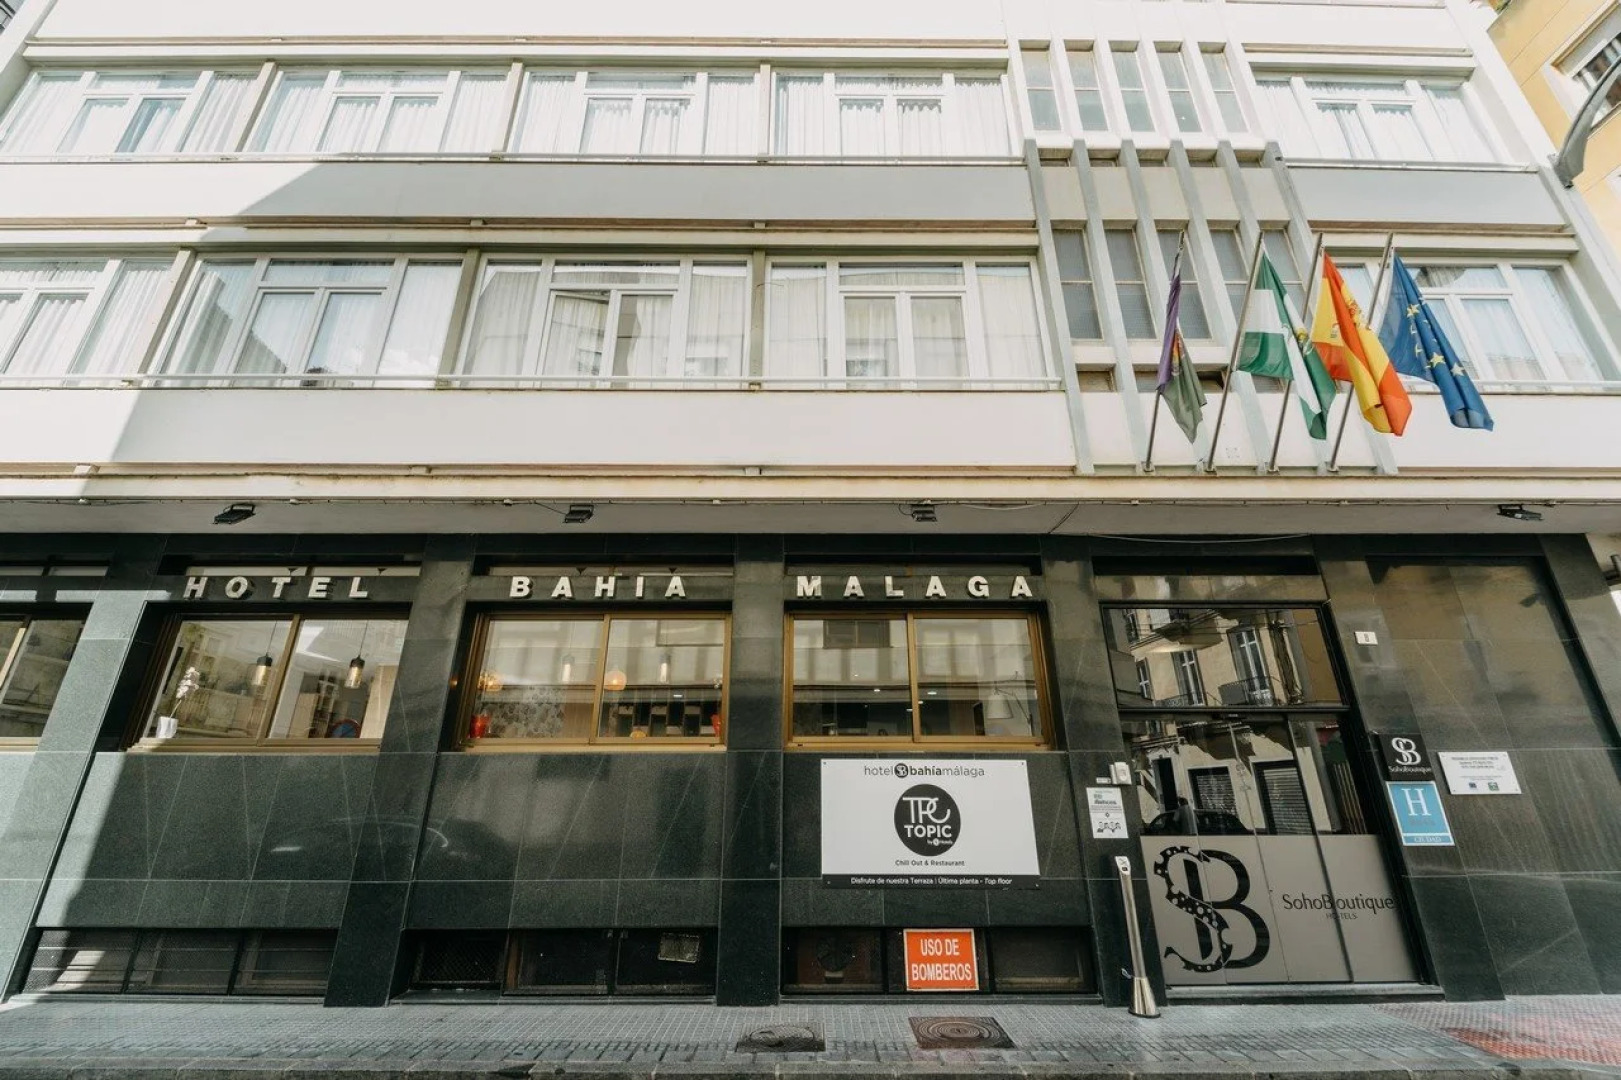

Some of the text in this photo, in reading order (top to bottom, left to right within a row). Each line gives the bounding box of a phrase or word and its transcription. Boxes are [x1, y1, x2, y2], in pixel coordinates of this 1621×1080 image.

[183, 575, 1033, 599] HOTEL BAHIA MALAGA
[1401, 788, 1432, 817] H
[903, 825, 953, 838] TOPIC
[895, 859, 910, 867] Chill
[911, 859, 923, 867] Out
[930, 859, 965, 867] Restaurant
[850, 877, 875, 885] Disfrute
[876, 877, 885, 885] de
[910, 877, 934, 885] Terraza
[959, 877, 979, 886] planta
[984, 877, 997, 886] Top
[997, 877, 1013, 885] floor
[1282, 892, 1395, 914] SohoBoutique
[920, 938, 960, 956] USO DE
[911, 963, 972, 981] BOMBEROS
